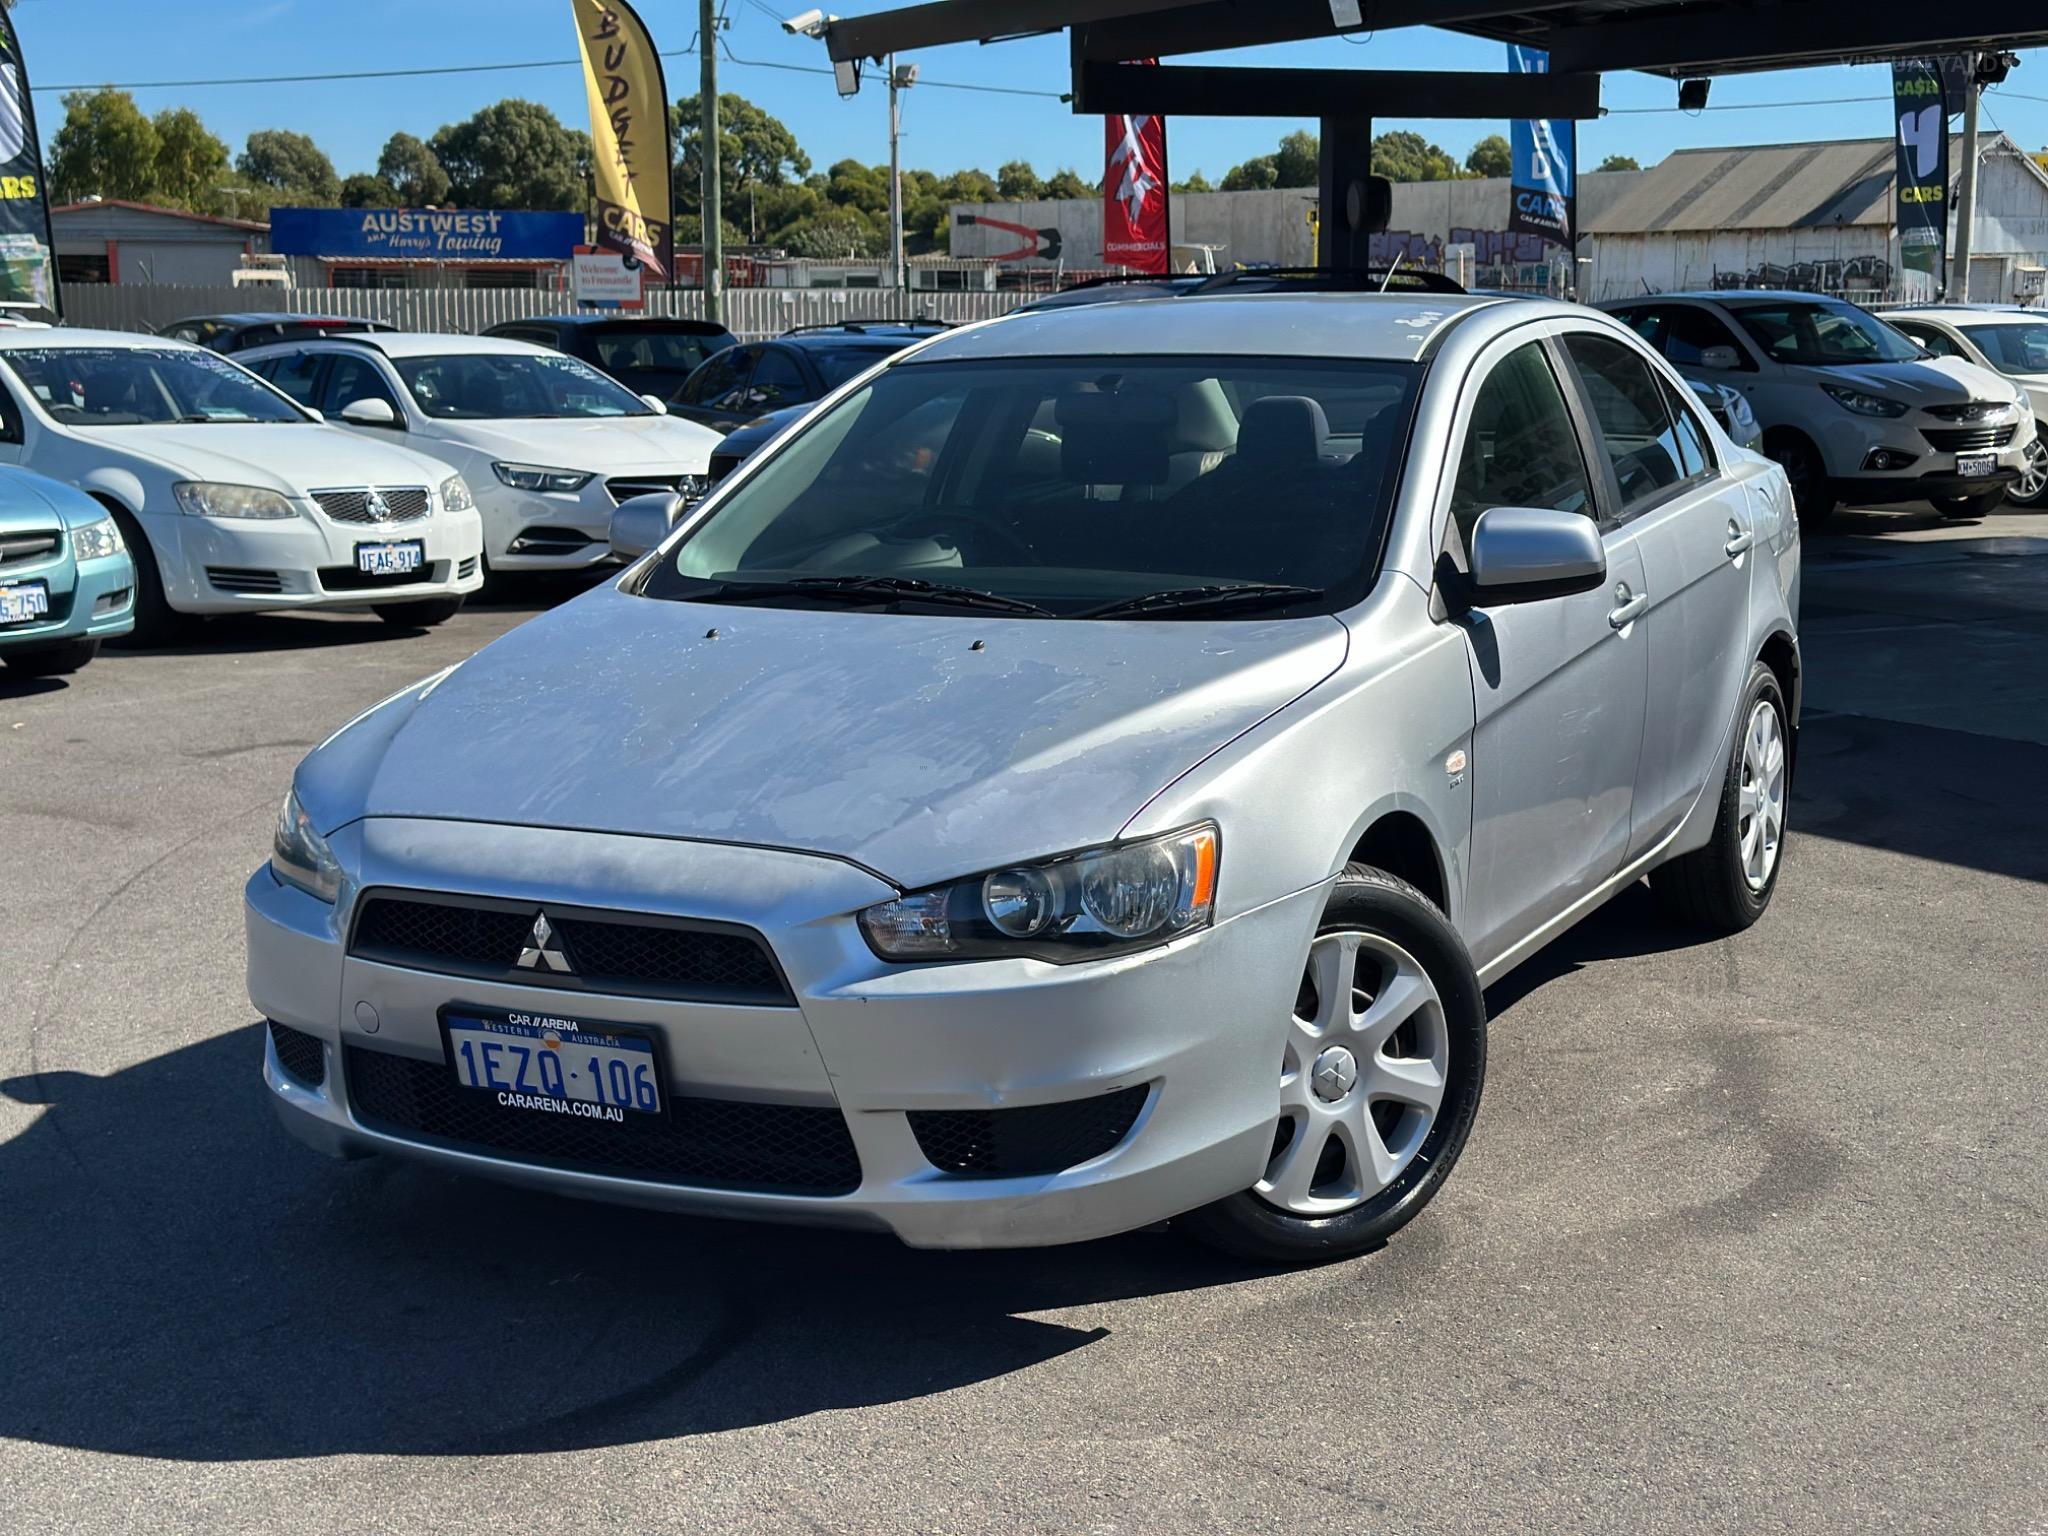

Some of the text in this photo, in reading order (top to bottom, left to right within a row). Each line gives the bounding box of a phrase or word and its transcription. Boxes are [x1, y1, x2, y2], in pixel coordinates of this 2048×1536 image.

[1900, 104, 1942, 178] 4
[1516, 193, 1566, 219] CARS
[1901, 185, 1944, 204] CARS
[361, 212, 502, 234] AUSTWEST
[603, 207, 662, 248] CARS
[437, 231, 503, 256] Towing
[1106, 241, 1167, 252] COMMERCIALS
[482, 1020, 621, 1048] WESTERN AUSTRALIA
[498, 1092, 624, 1123] CARARENA.COM.AU
